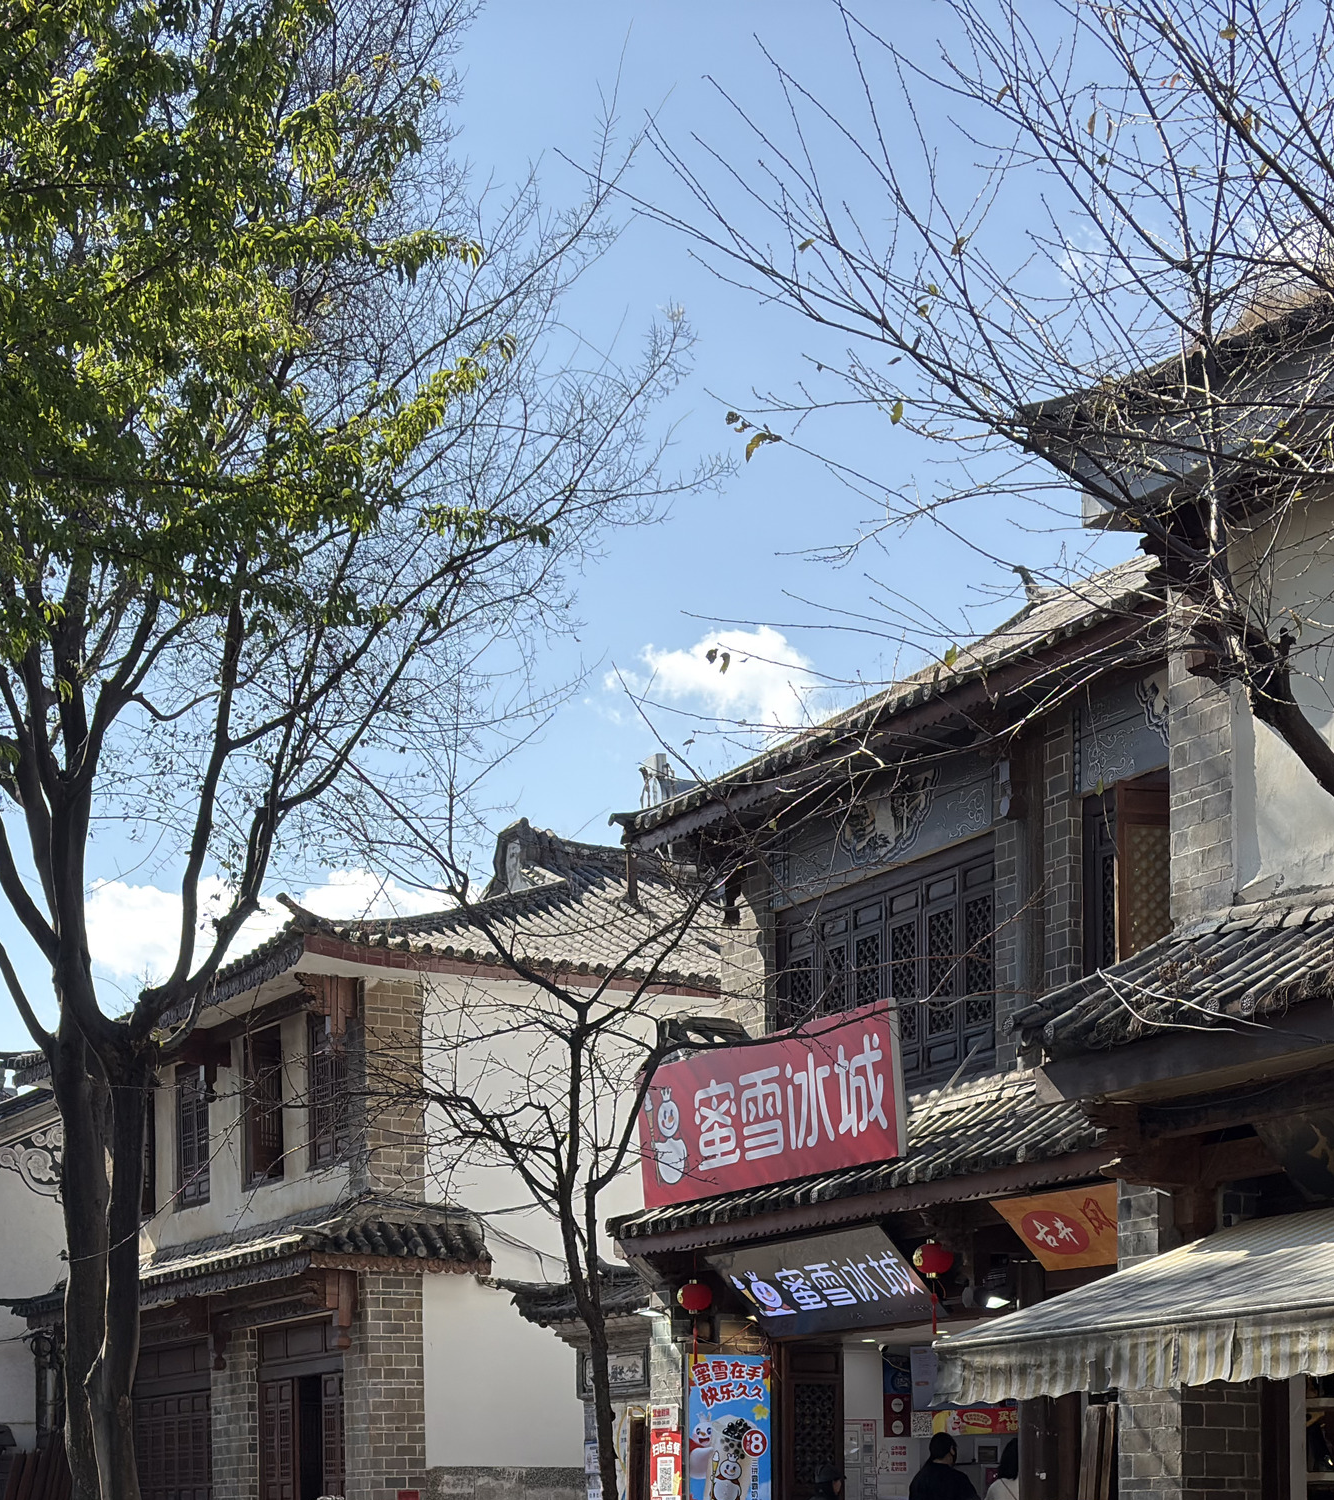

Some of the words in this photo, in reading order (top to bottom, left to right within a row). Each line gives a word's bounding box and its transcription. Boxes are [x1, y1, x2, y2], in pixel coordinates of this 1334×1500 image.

[694, 1033, 890, 1170] 蜜雪冰城
[775, 1251, 925, 1311] 蜜雪冰城
[691, 1360, 763, 1387] 蜜雪在手
[700, 1382, 764, 1408] 快乐久久
